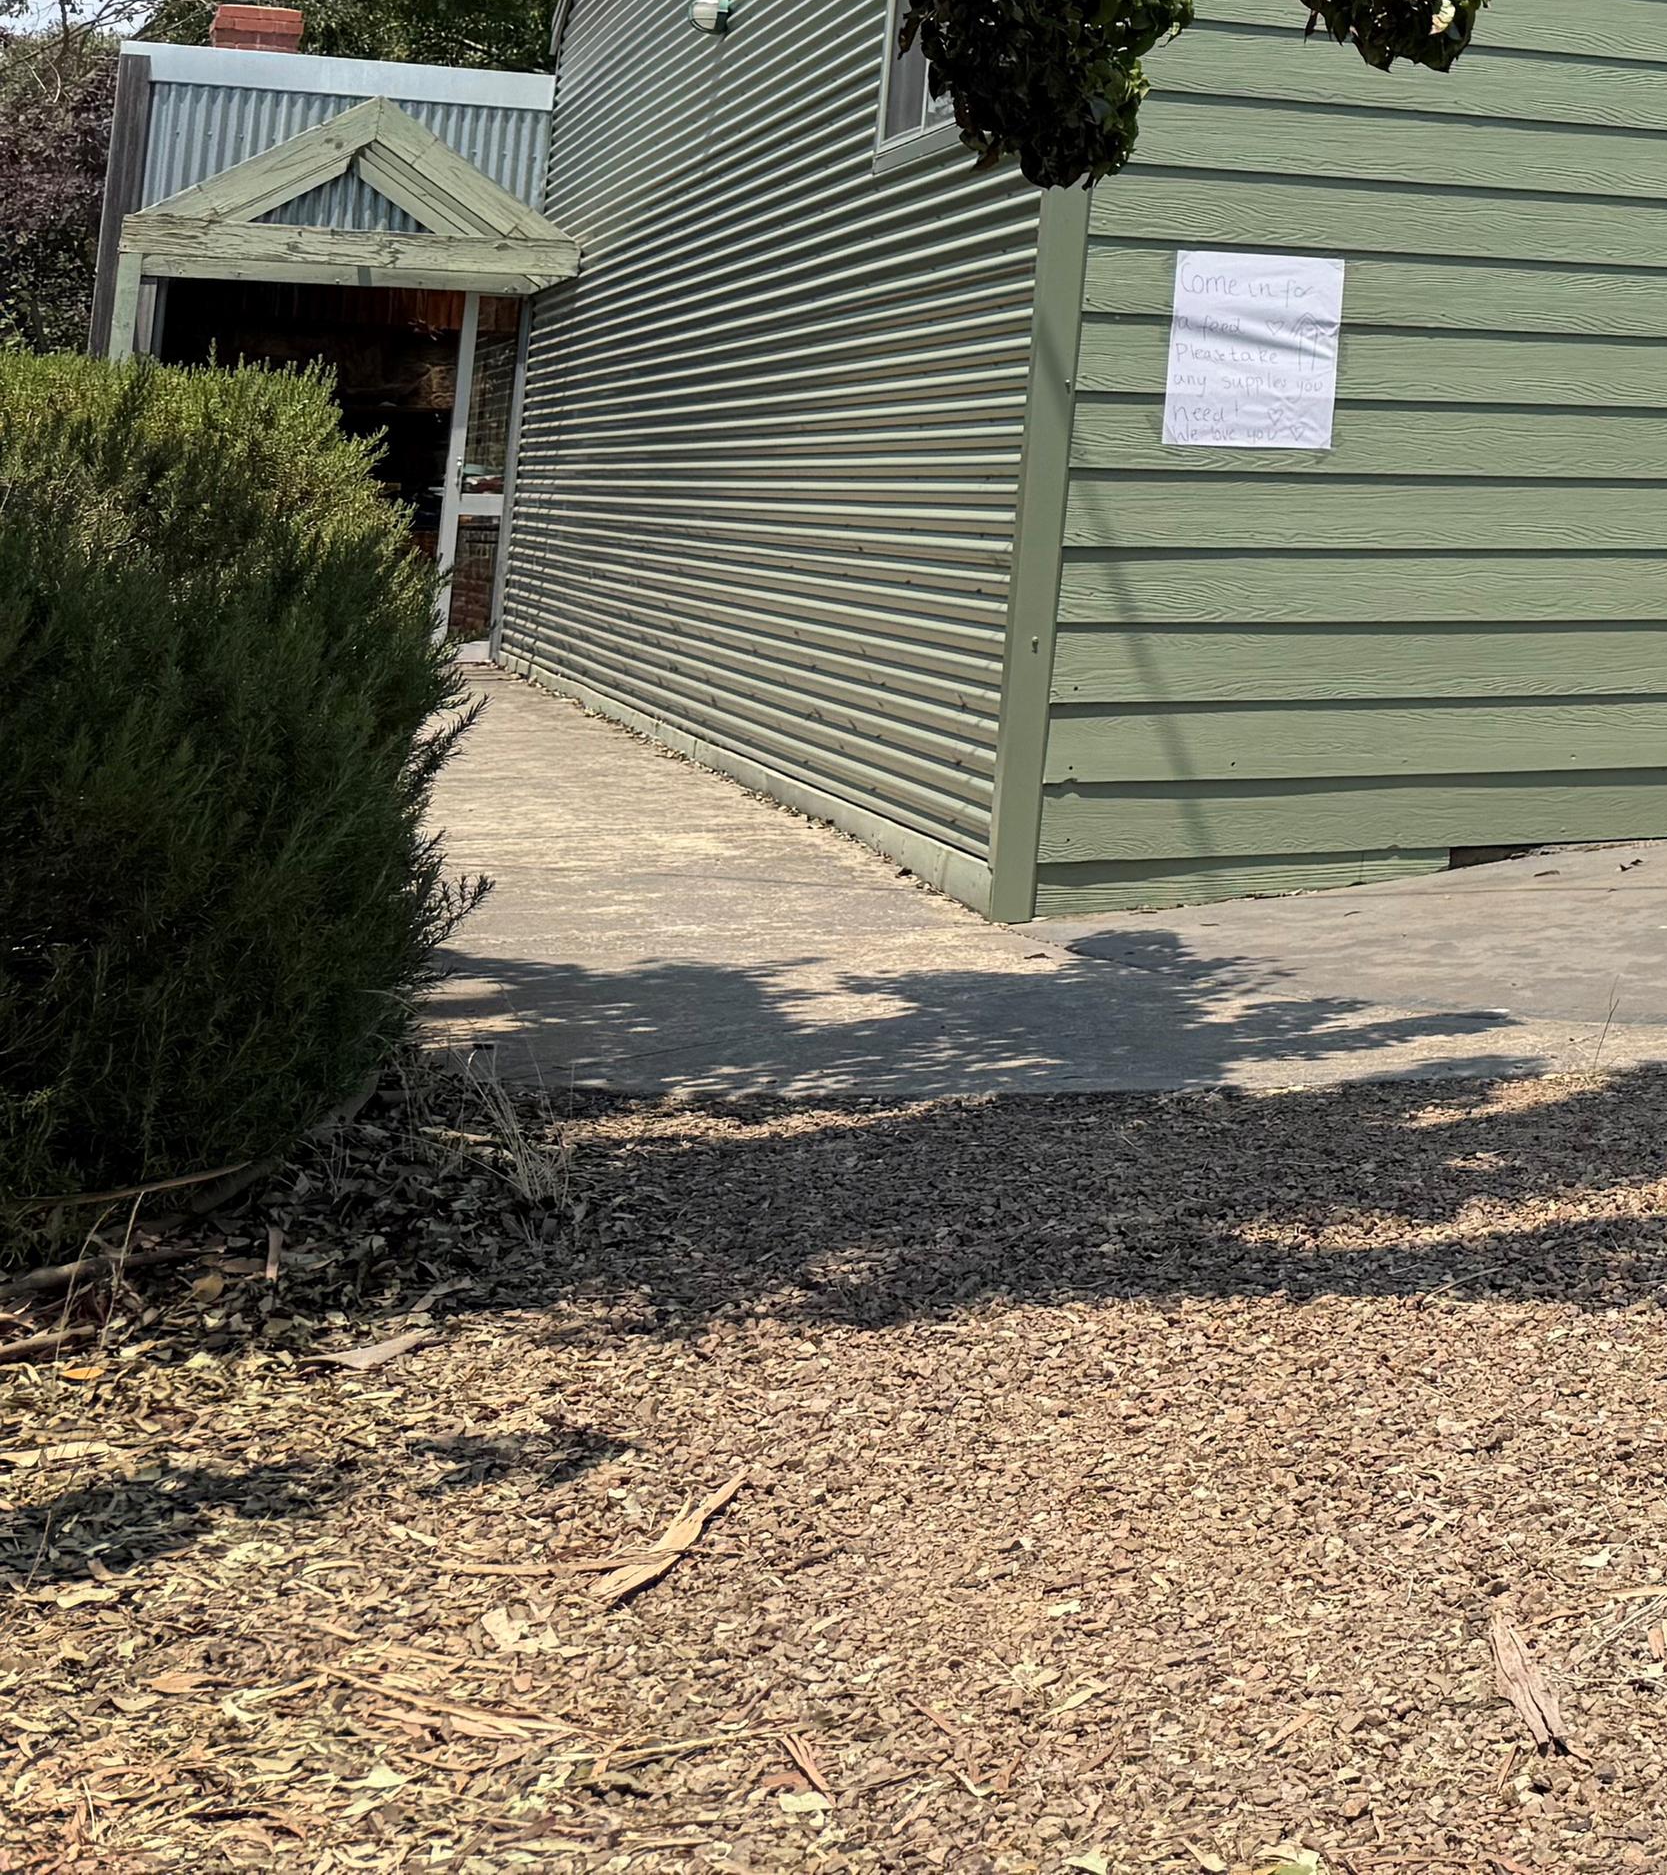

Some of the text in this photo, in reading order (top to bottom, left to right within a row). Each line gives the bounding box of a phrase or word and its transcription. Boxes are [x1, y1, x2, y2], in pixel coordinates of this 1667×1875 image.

[1181, 262, 1313, 309] Come in for
[1177, 314, 1245, 341] a feed
[1229, 345, 1279, 365] take
[1173, 372, 1207, 398] any
[1290, 377, 1324, 404] you
[1168, 424, 1199, 442] We
[1246, 427, 1278, 443] you
